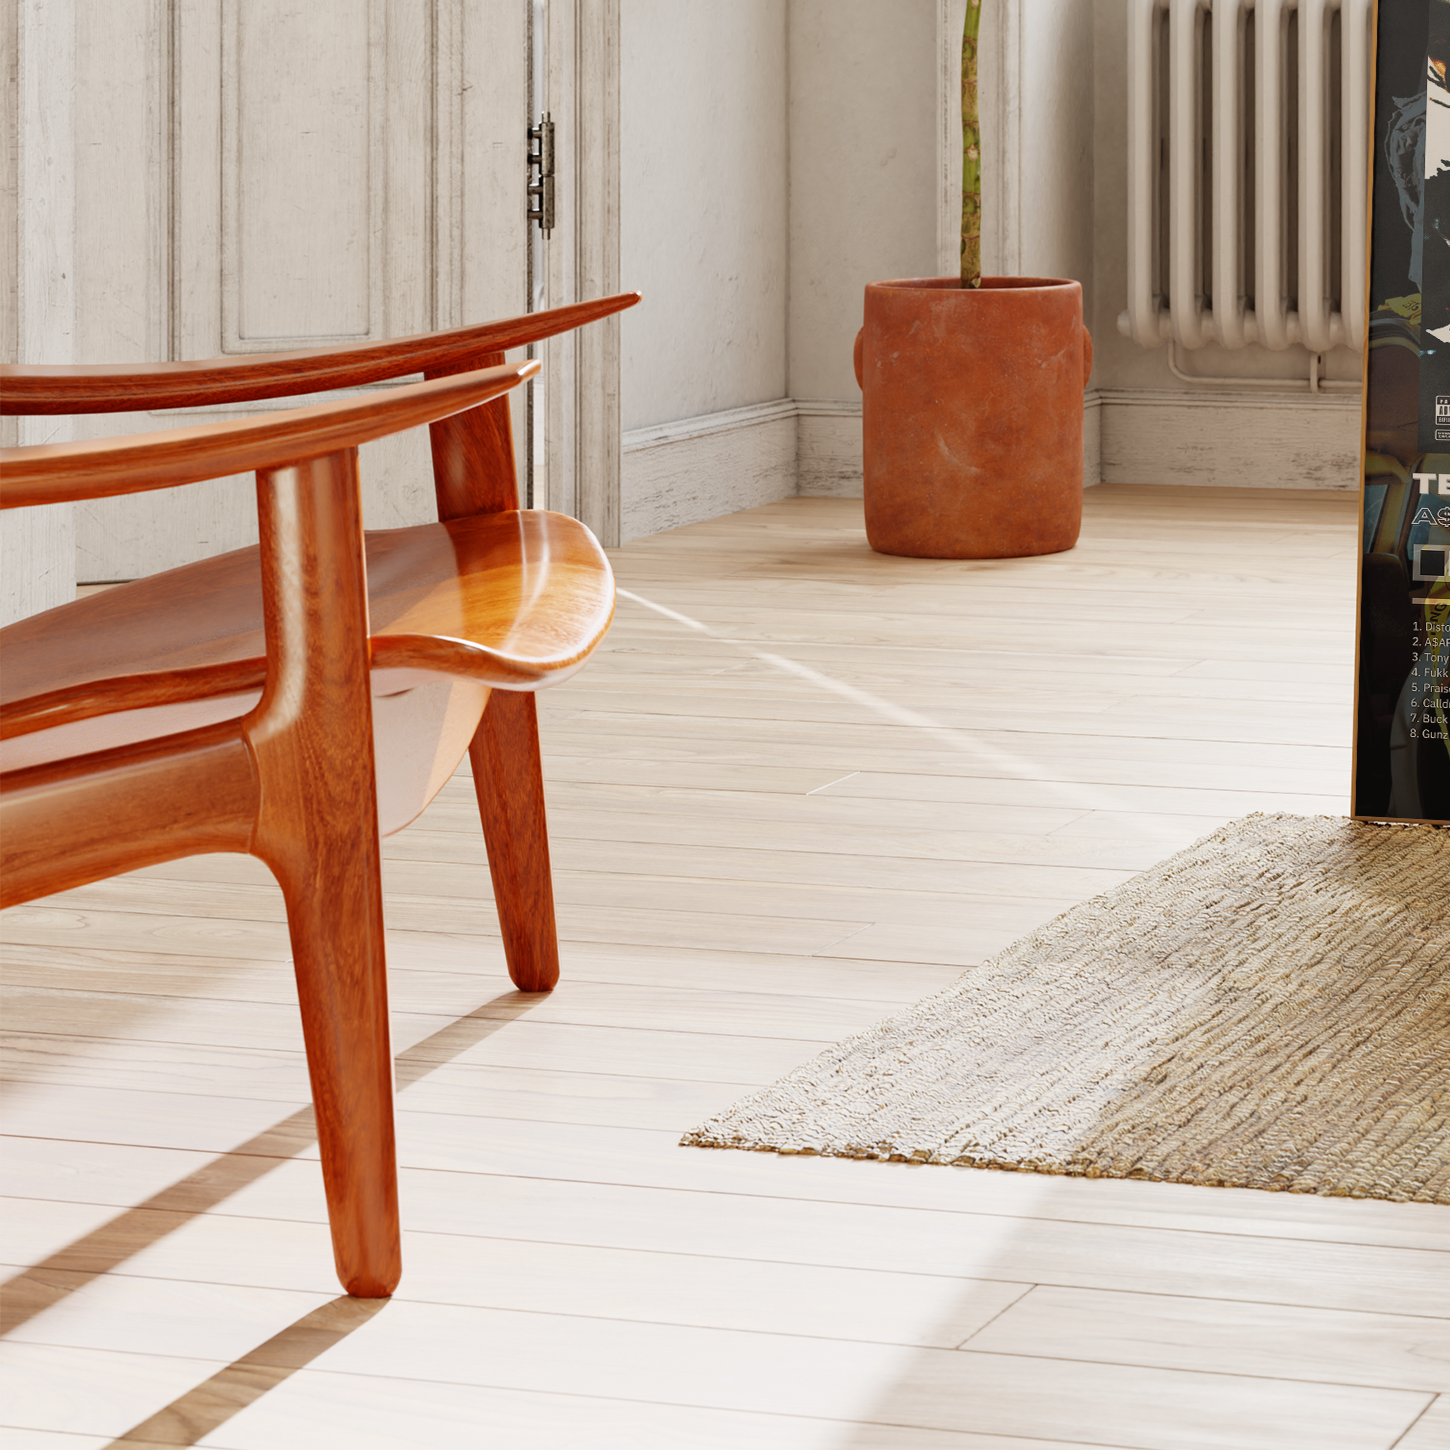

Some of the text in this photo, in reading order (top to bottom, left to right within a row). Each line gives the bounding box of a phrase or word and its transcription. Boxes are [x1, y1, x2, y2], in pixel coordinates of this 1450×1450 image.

[1413, 622, 1422, 632] 1.
[1412, 637, 1422, 647] 2.
[1412, 652, 1421, 662] 3.
[1424, 653, 1449, 665] Tony
[1411, 668, 1421, 677] 4.
[1424, 668, 1448, 678] Fukk
[1411, 683, 1420, 692] 5.
[1410, 699, 1420, 708] 6.
[1410, 713, 1419, 723] 7.
[1423, 714, 1448, 724] Buck
[1410, 728, 1419, 738] 8.
[1422, 729, 1448, 739] Gunz
